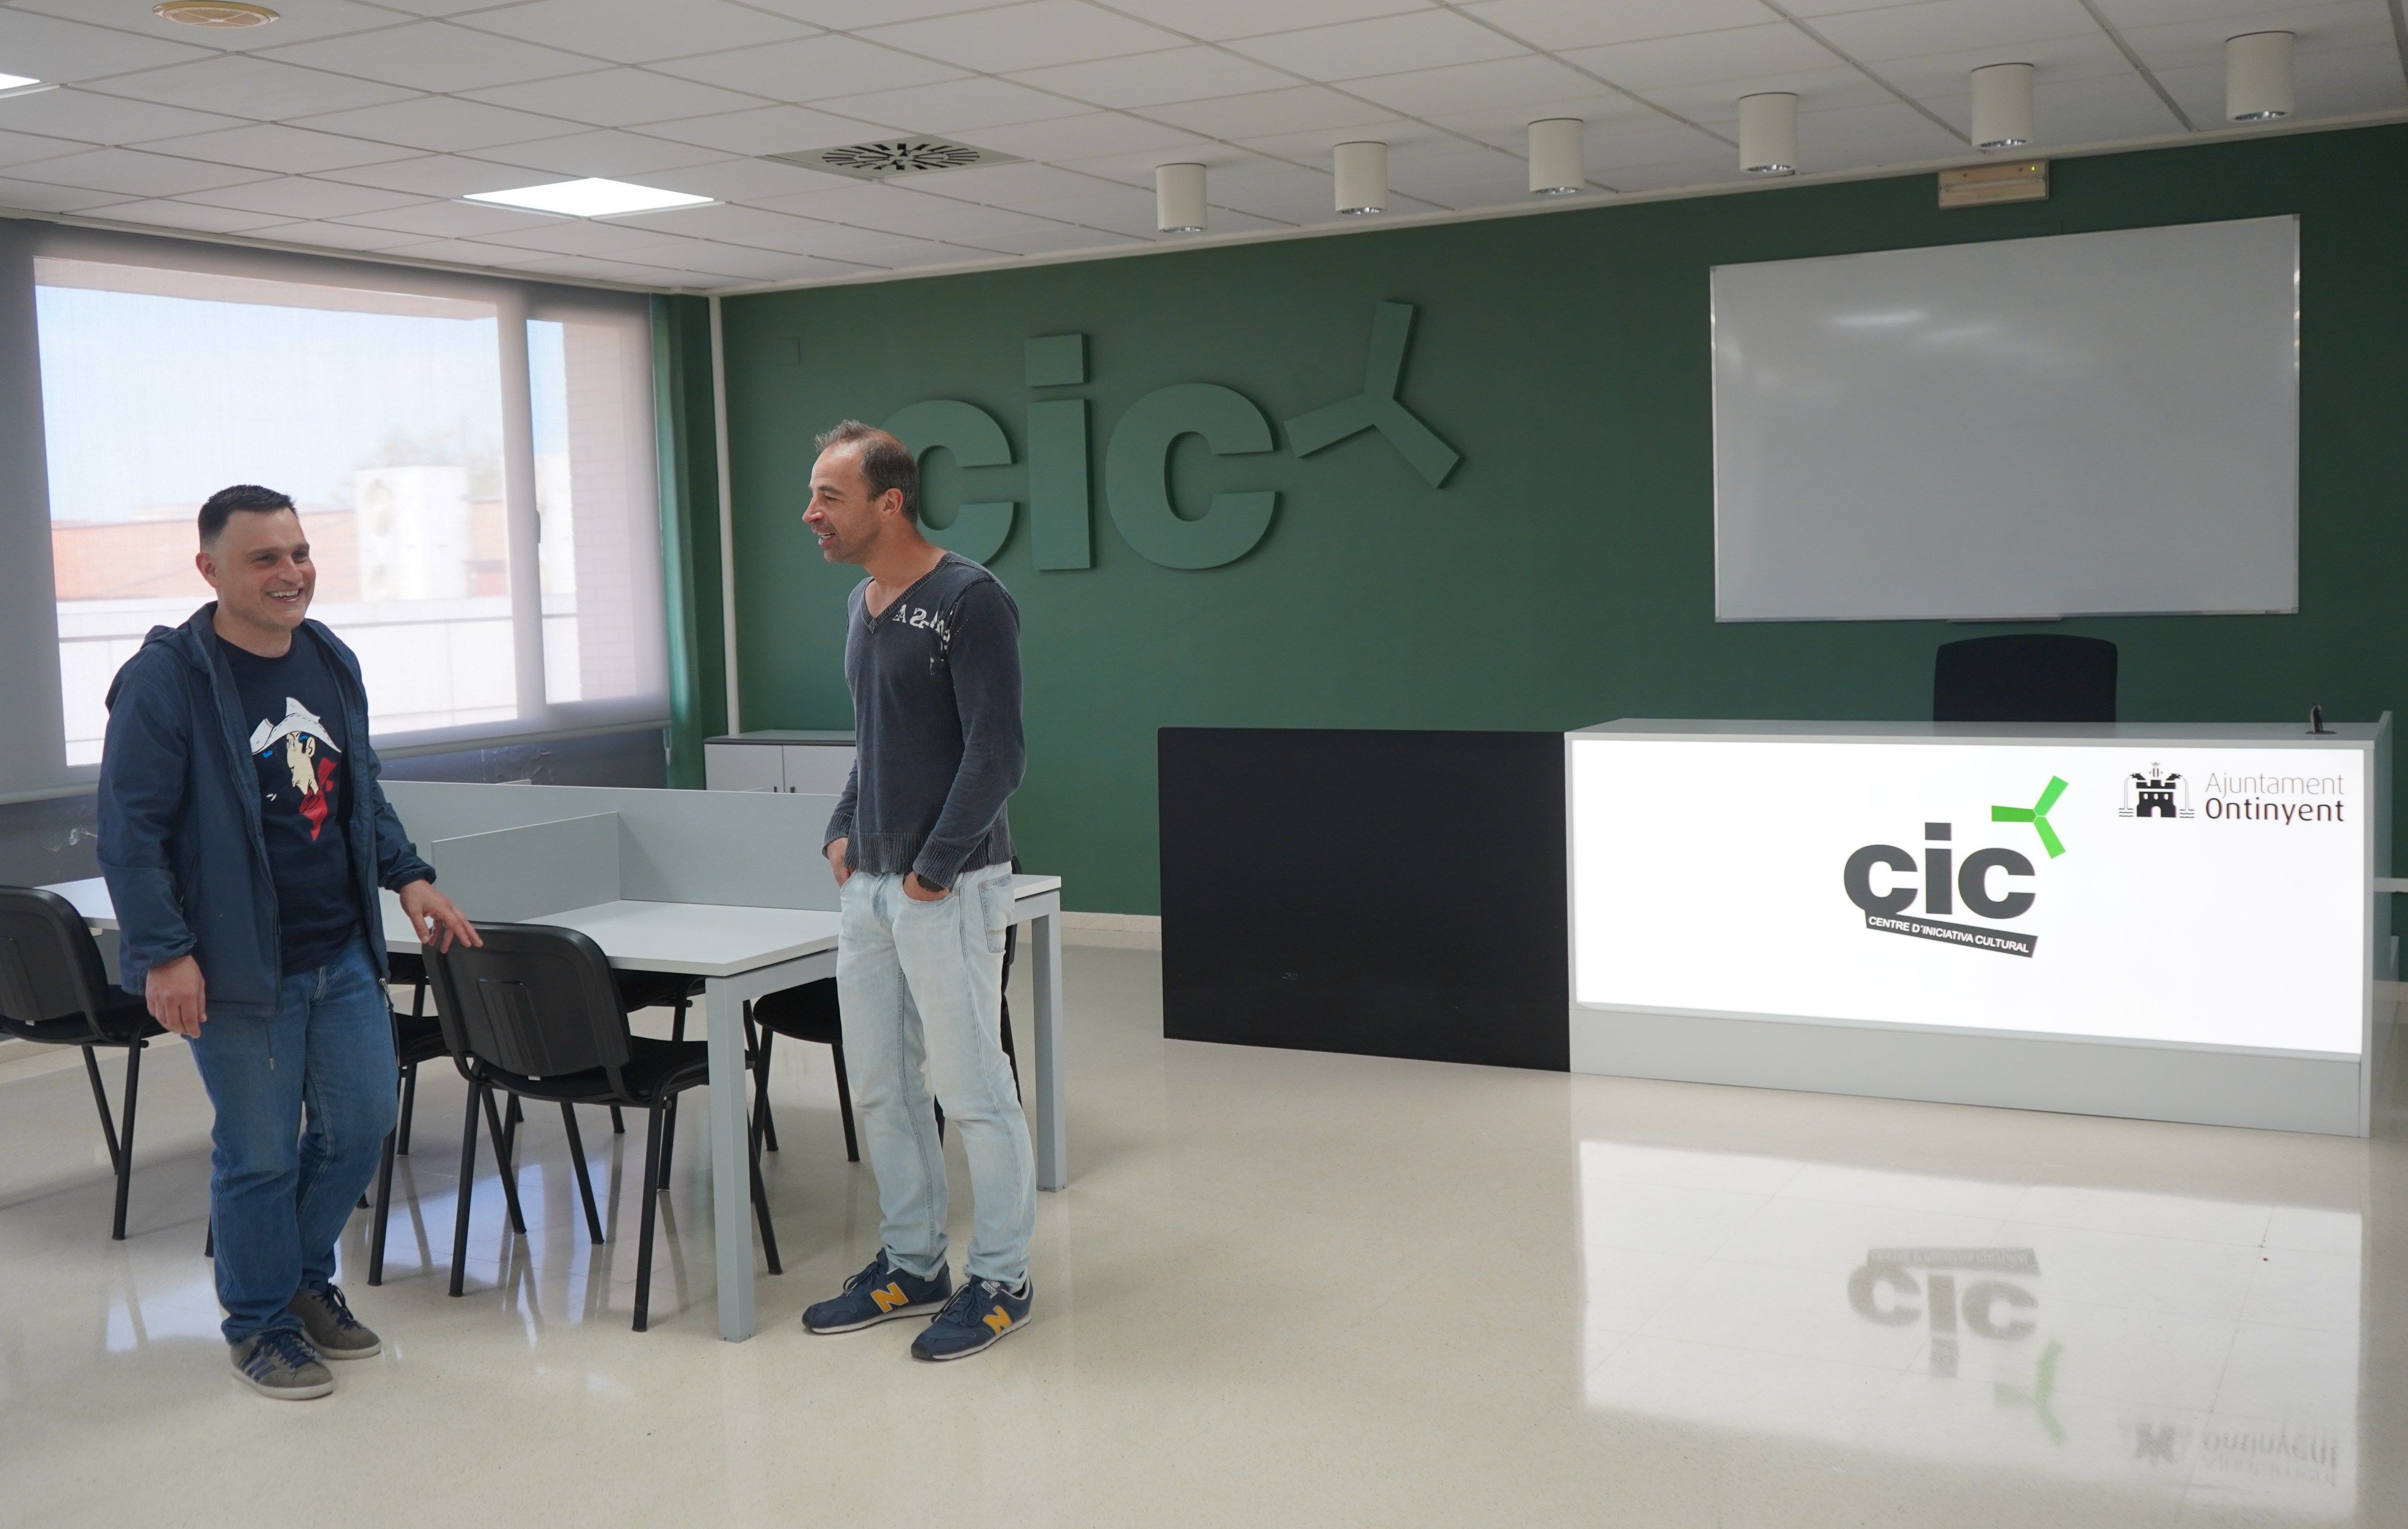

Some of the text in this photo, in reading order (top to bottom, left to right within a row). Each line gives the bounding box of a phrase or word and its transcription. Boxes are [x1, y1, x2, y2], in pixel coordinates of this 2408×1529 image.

[882, 333, 1280, 571] cic
[2206, 773, 2345, 798] Ajuntament
[2205, 797, 2345, 825] Ontinyent
[1843, 822, 2037, 919] cic
[1868, 916, 1910, 931] CENTRE
[1975, 935, 2029, 953] CULTURAL
